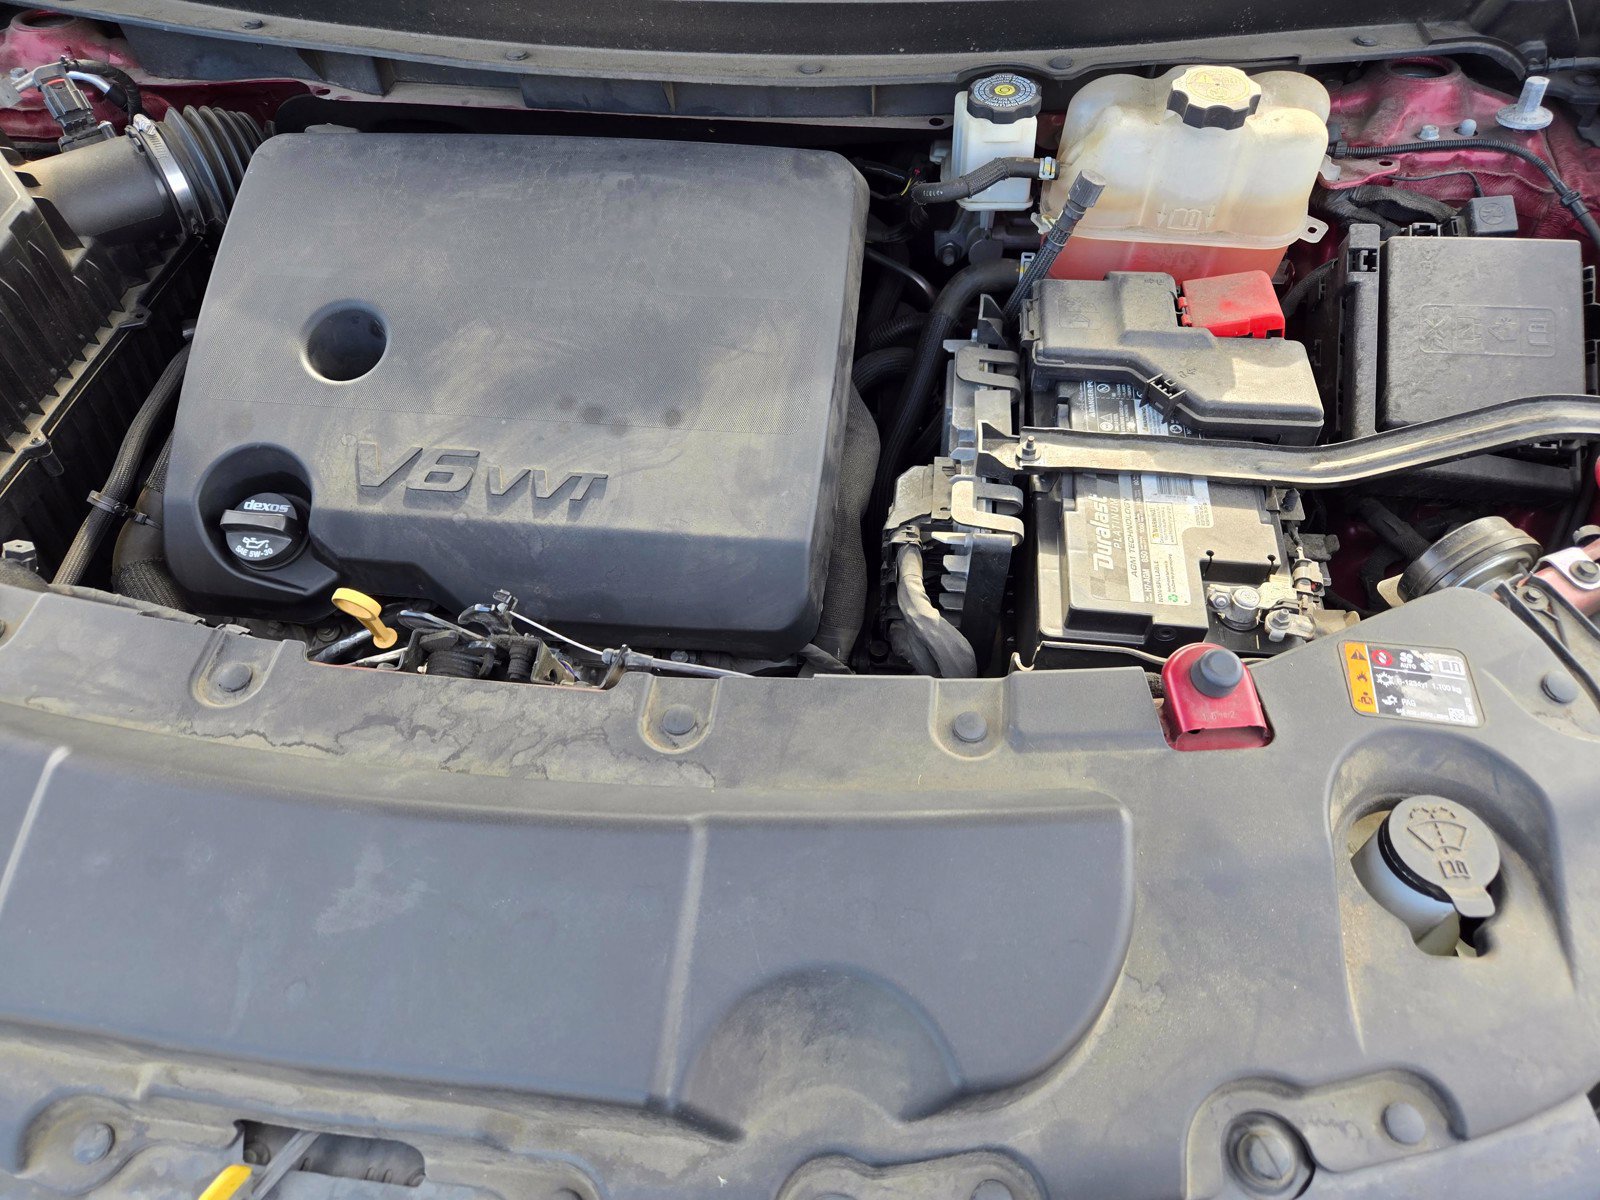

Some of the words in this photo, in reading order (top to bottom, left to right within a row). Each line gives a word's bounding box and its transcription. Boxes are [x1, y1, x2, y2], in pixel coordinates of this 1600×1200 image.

[356, 440, 480, 493] V6
[487, 466, 609, 502] VVT
[244, 500, 290, 513] dexos
[1109, 496, 1122, 549] PLATINUM
[1088, 493, 1114, 571] Duralast
[1123, 497, 1137, 554] TECHNOLOGY
[235, 545, 248, 556] SAE
[249, 547, 273, 558] 5W-30
[1128, 555, 1138, 577] AGM
[1400, 662, 1417, 670] AUTO
